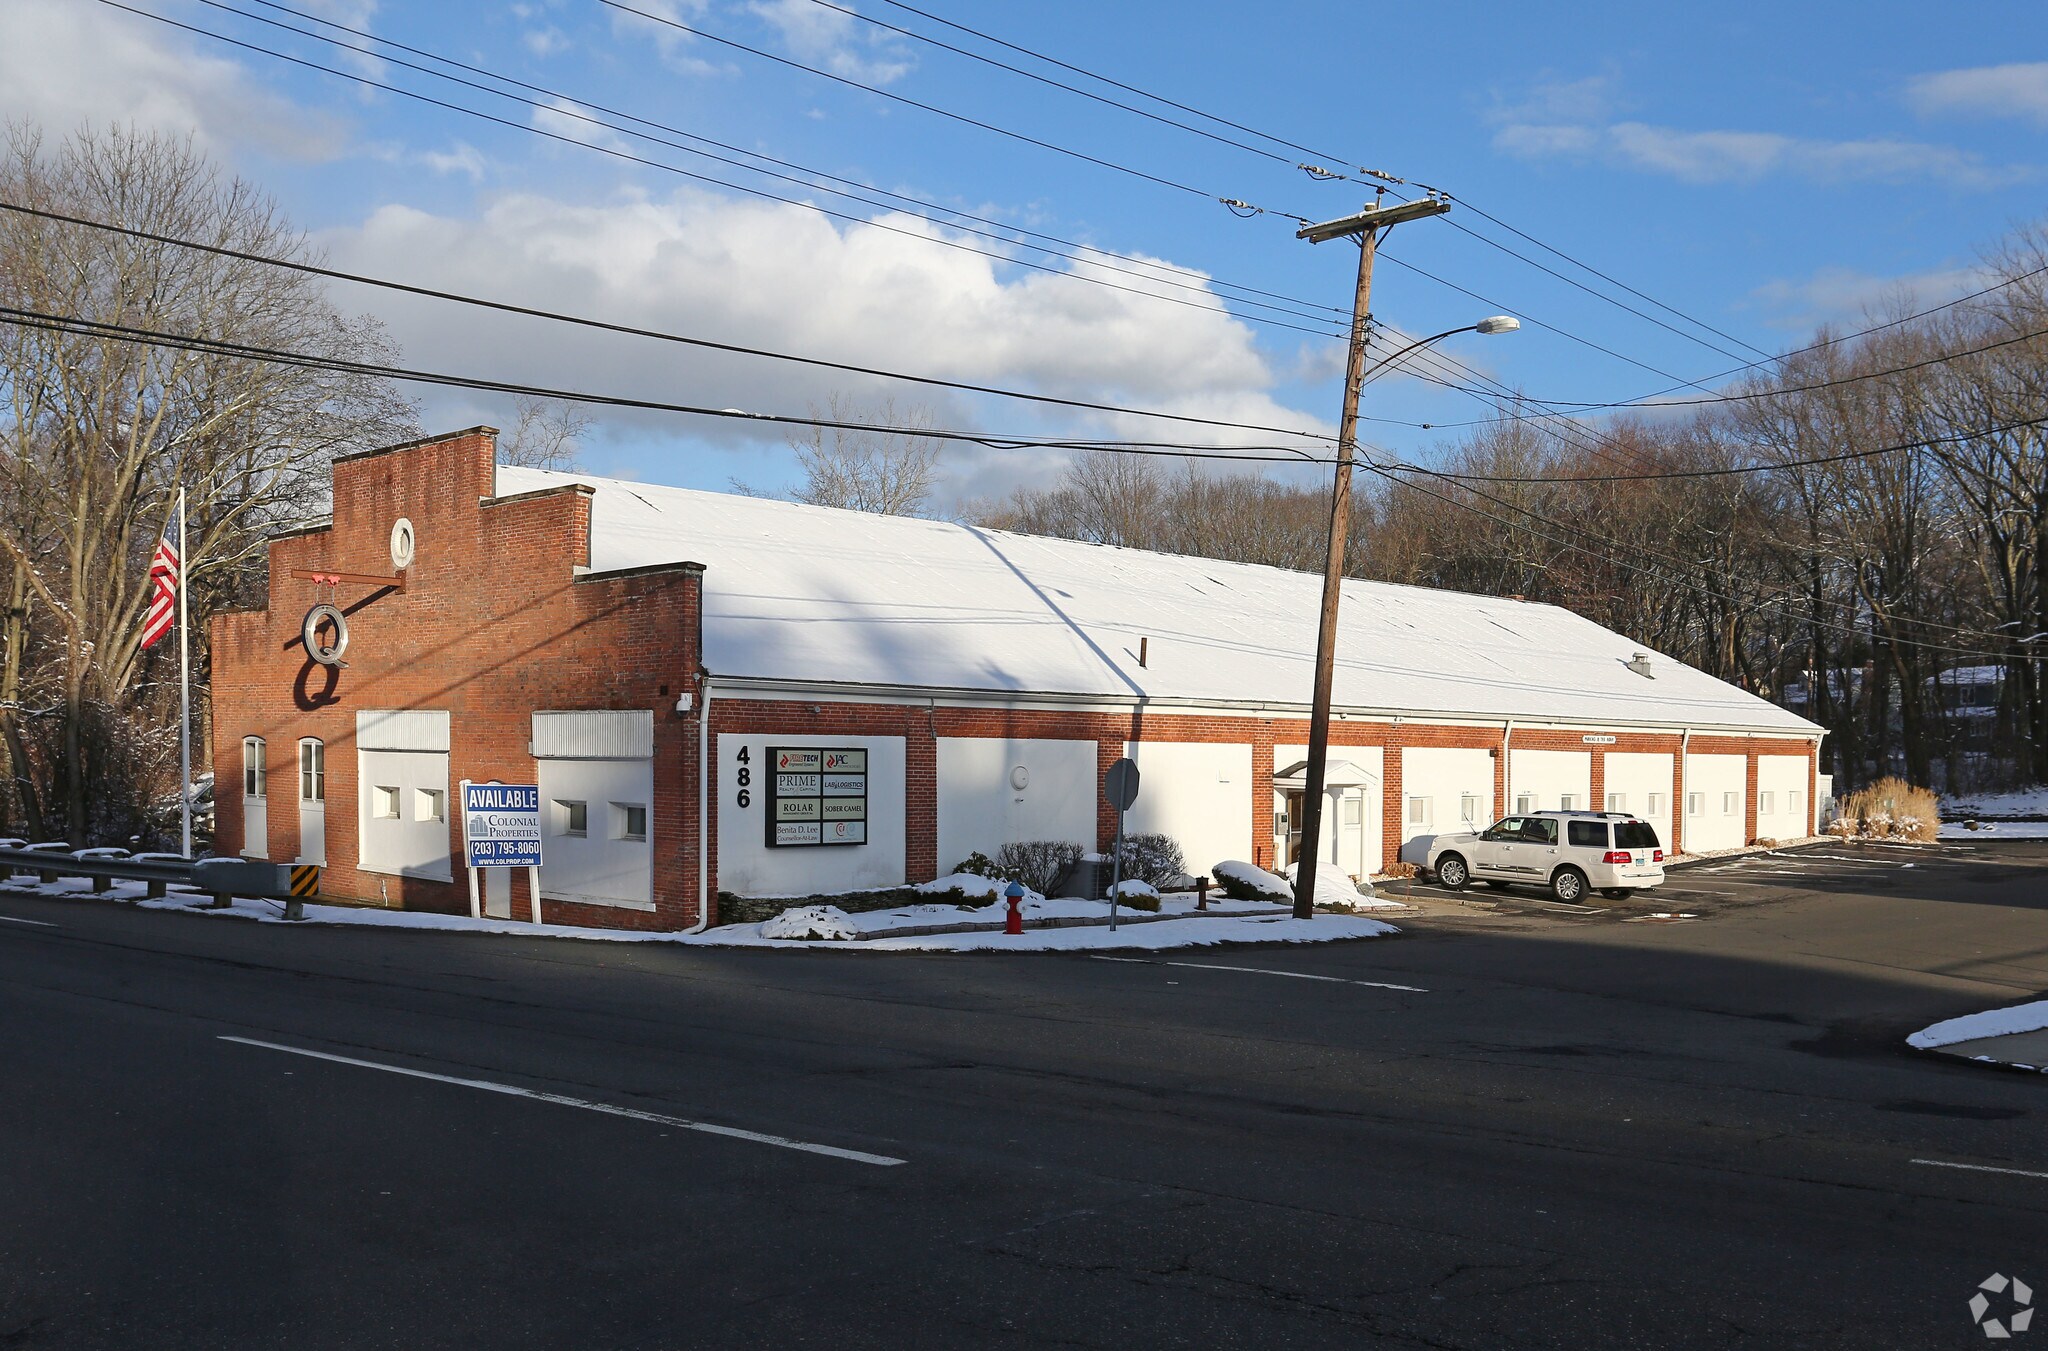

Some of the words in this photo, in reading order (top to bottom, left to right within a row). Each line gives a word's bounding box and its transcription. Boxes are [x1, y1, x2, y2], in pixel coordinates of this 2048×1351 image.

[833, 754, 849, 768] JAC
[737, 746, 750, 808] 486
[778, 775, 817, 787] PRIME
[469, 789, 537, 808] AVAILABLE
[783, 803, 814, 812] ROLAR
[824, 805, 844, 813] SOBER
[488, 814, 539, 827] COLONIAL
[489, 827, 539, 838] PROPERTIES
[777, 826, 797, 834] Benita
[797, 825, 806, 834] D.
[471, 841, 496, 857] (203)
[498, 841, 540, 854] 795-8060
